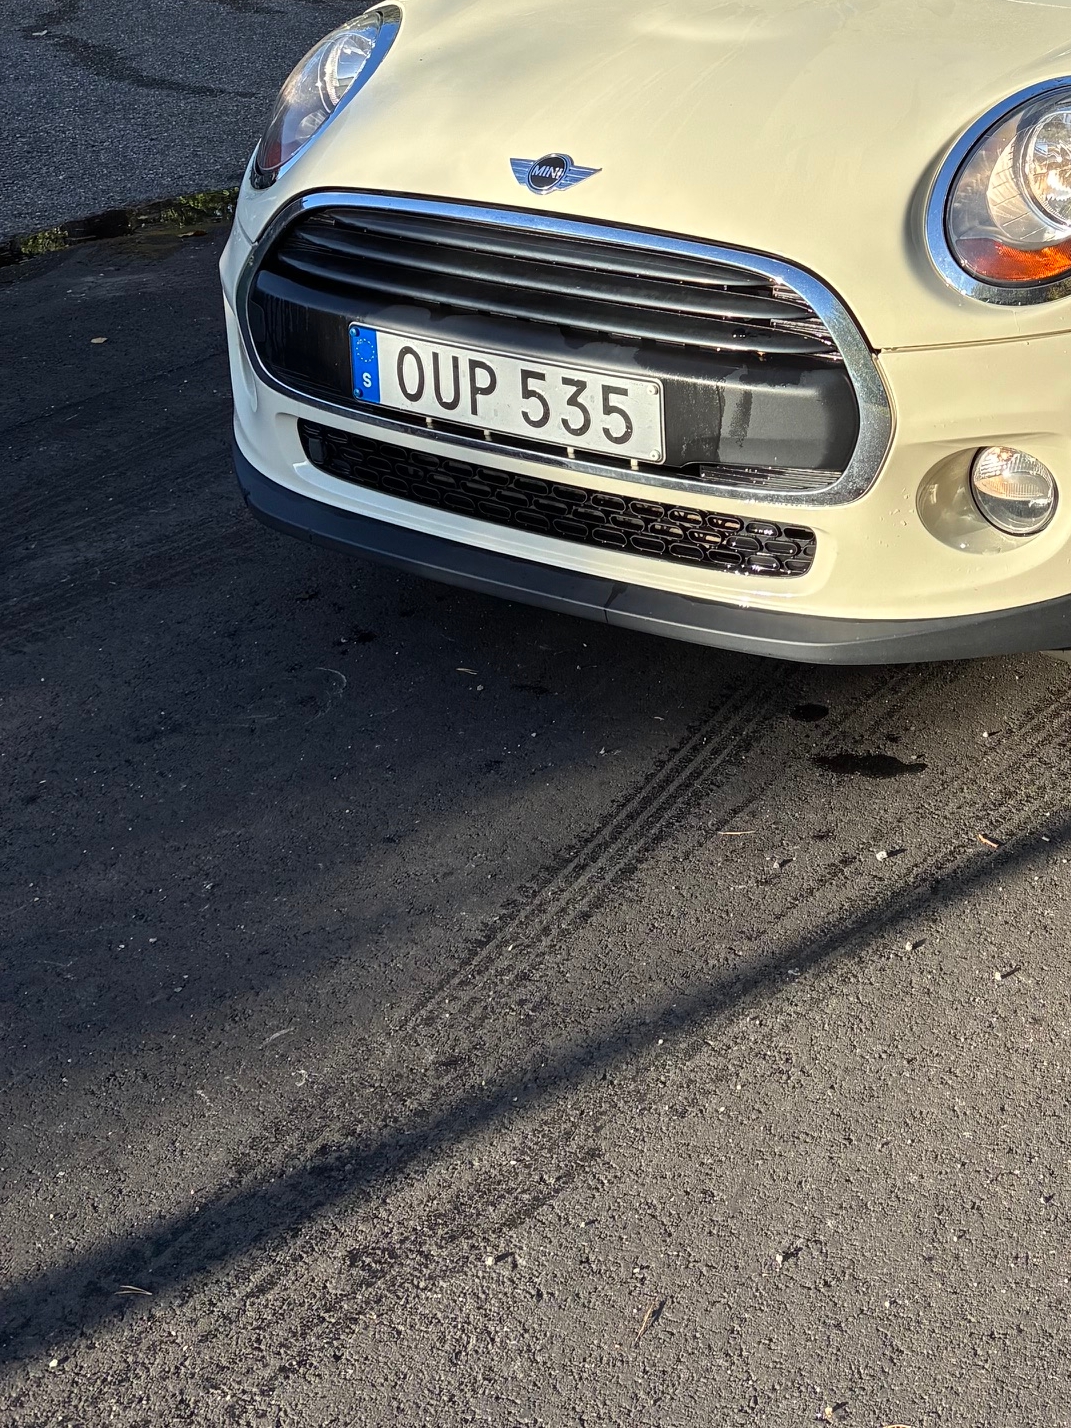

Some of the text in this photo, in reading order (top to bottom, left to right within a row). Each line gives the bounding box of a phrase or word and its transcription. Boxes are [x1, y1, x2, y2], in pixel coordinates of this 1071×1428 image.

[531, 165, 564, 179] MINI
[362, 372, 372, 388] S
[397, 346, 634, 445] OUP 535
